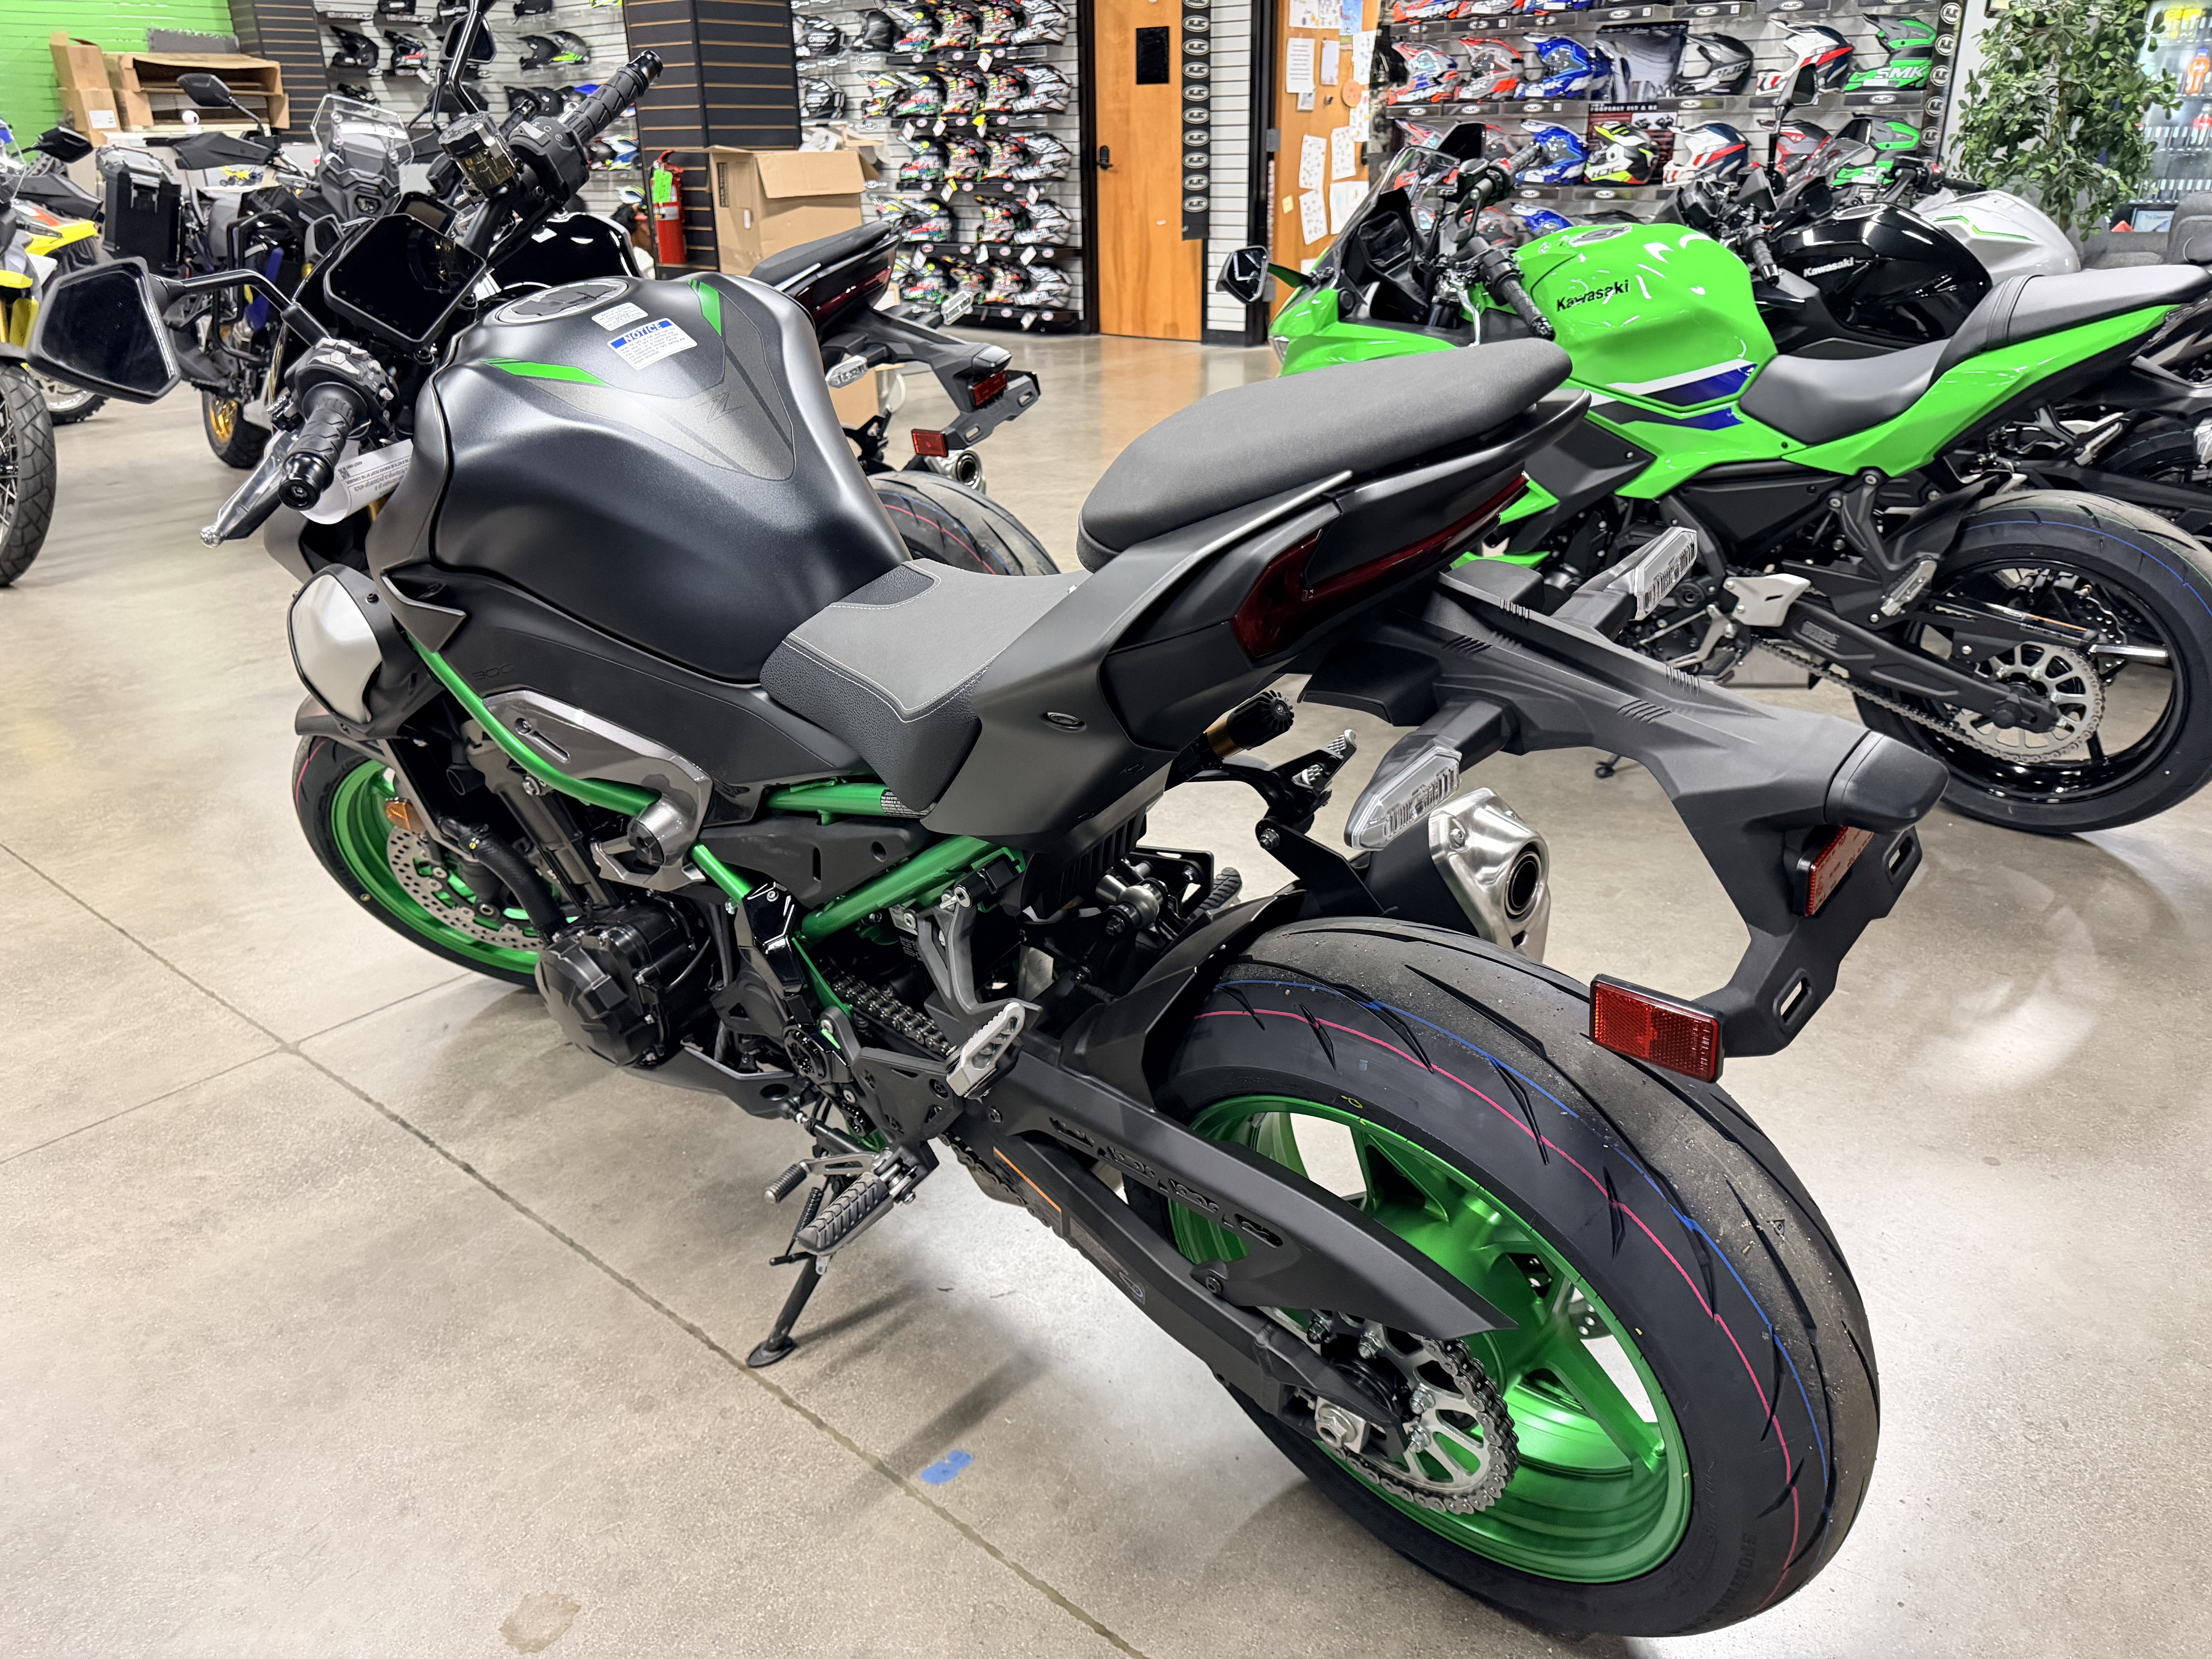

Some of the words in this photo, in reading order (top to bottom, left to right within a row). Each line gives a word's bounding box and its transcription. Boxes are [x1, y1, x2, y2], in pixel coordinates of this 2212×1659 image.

[1874, 66, 1930, 78] SMK
[1803, 257, 1854, 277] Kawasaki
[1556, 279, 1629, 312] Kawasaki
[623, 323, 663, 343] NOTICE
